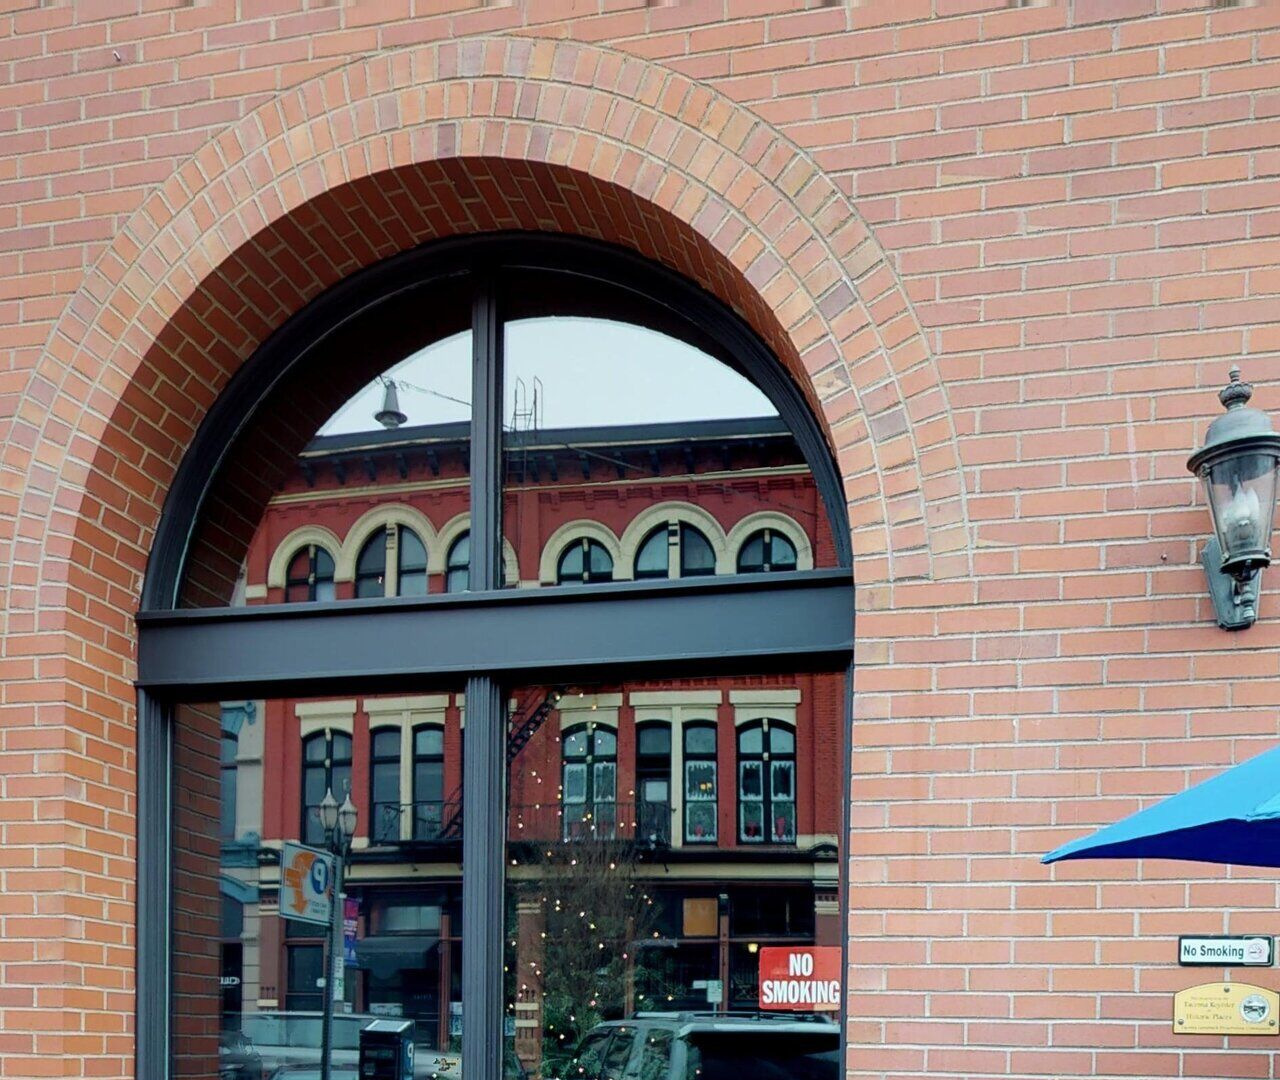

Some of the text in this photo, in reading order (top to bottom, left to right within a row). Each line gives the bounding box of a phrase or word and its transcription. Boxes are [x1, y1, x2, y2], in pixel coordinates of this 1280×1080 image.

[789, 952, 814, 977] NO
[1183, 945, 1245, 960] No Smoking
[761, 980, 840, 1004] SMOKING
